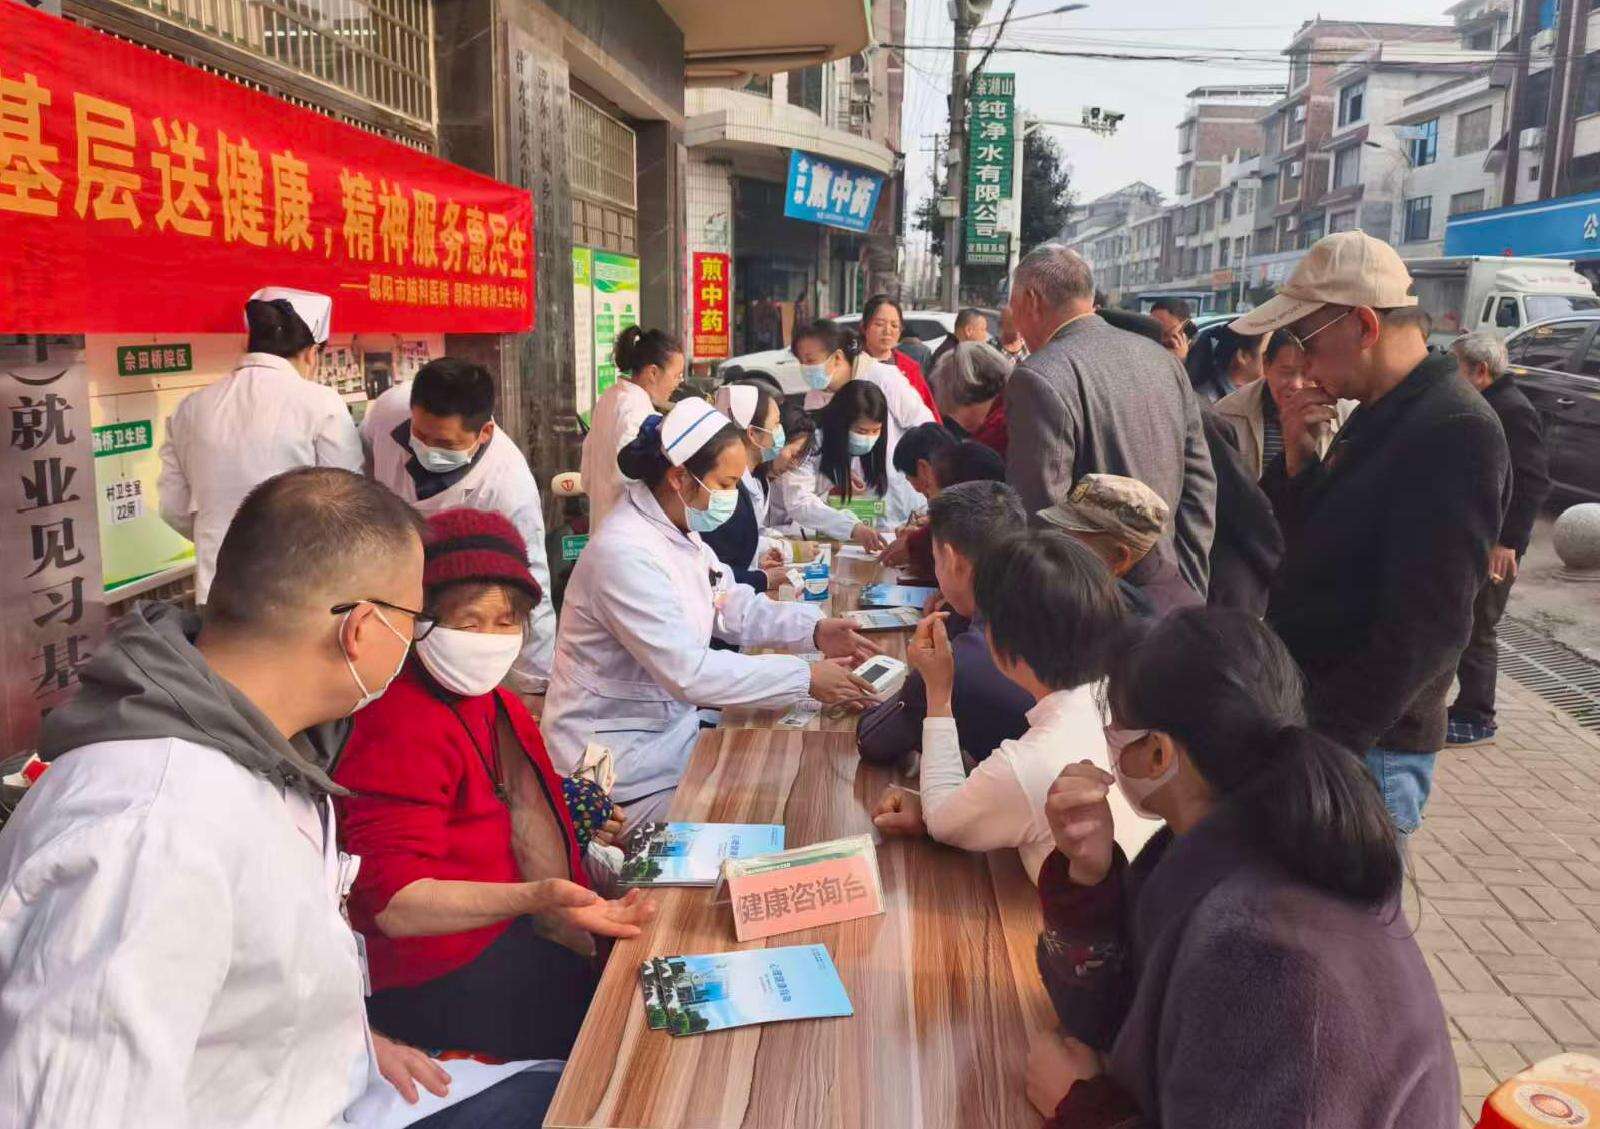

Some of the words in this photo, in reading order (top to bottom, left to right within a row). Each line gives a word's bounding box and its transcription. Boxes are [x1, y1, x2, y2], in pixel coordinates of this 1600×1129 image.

[974, 100, 1008, 238] 纯净水有限公司
[1584, 213, 1600, 240] 公
[700, 257, 724, 332] 煎中药
[737, 874, 867, 925] 健康咨询台
